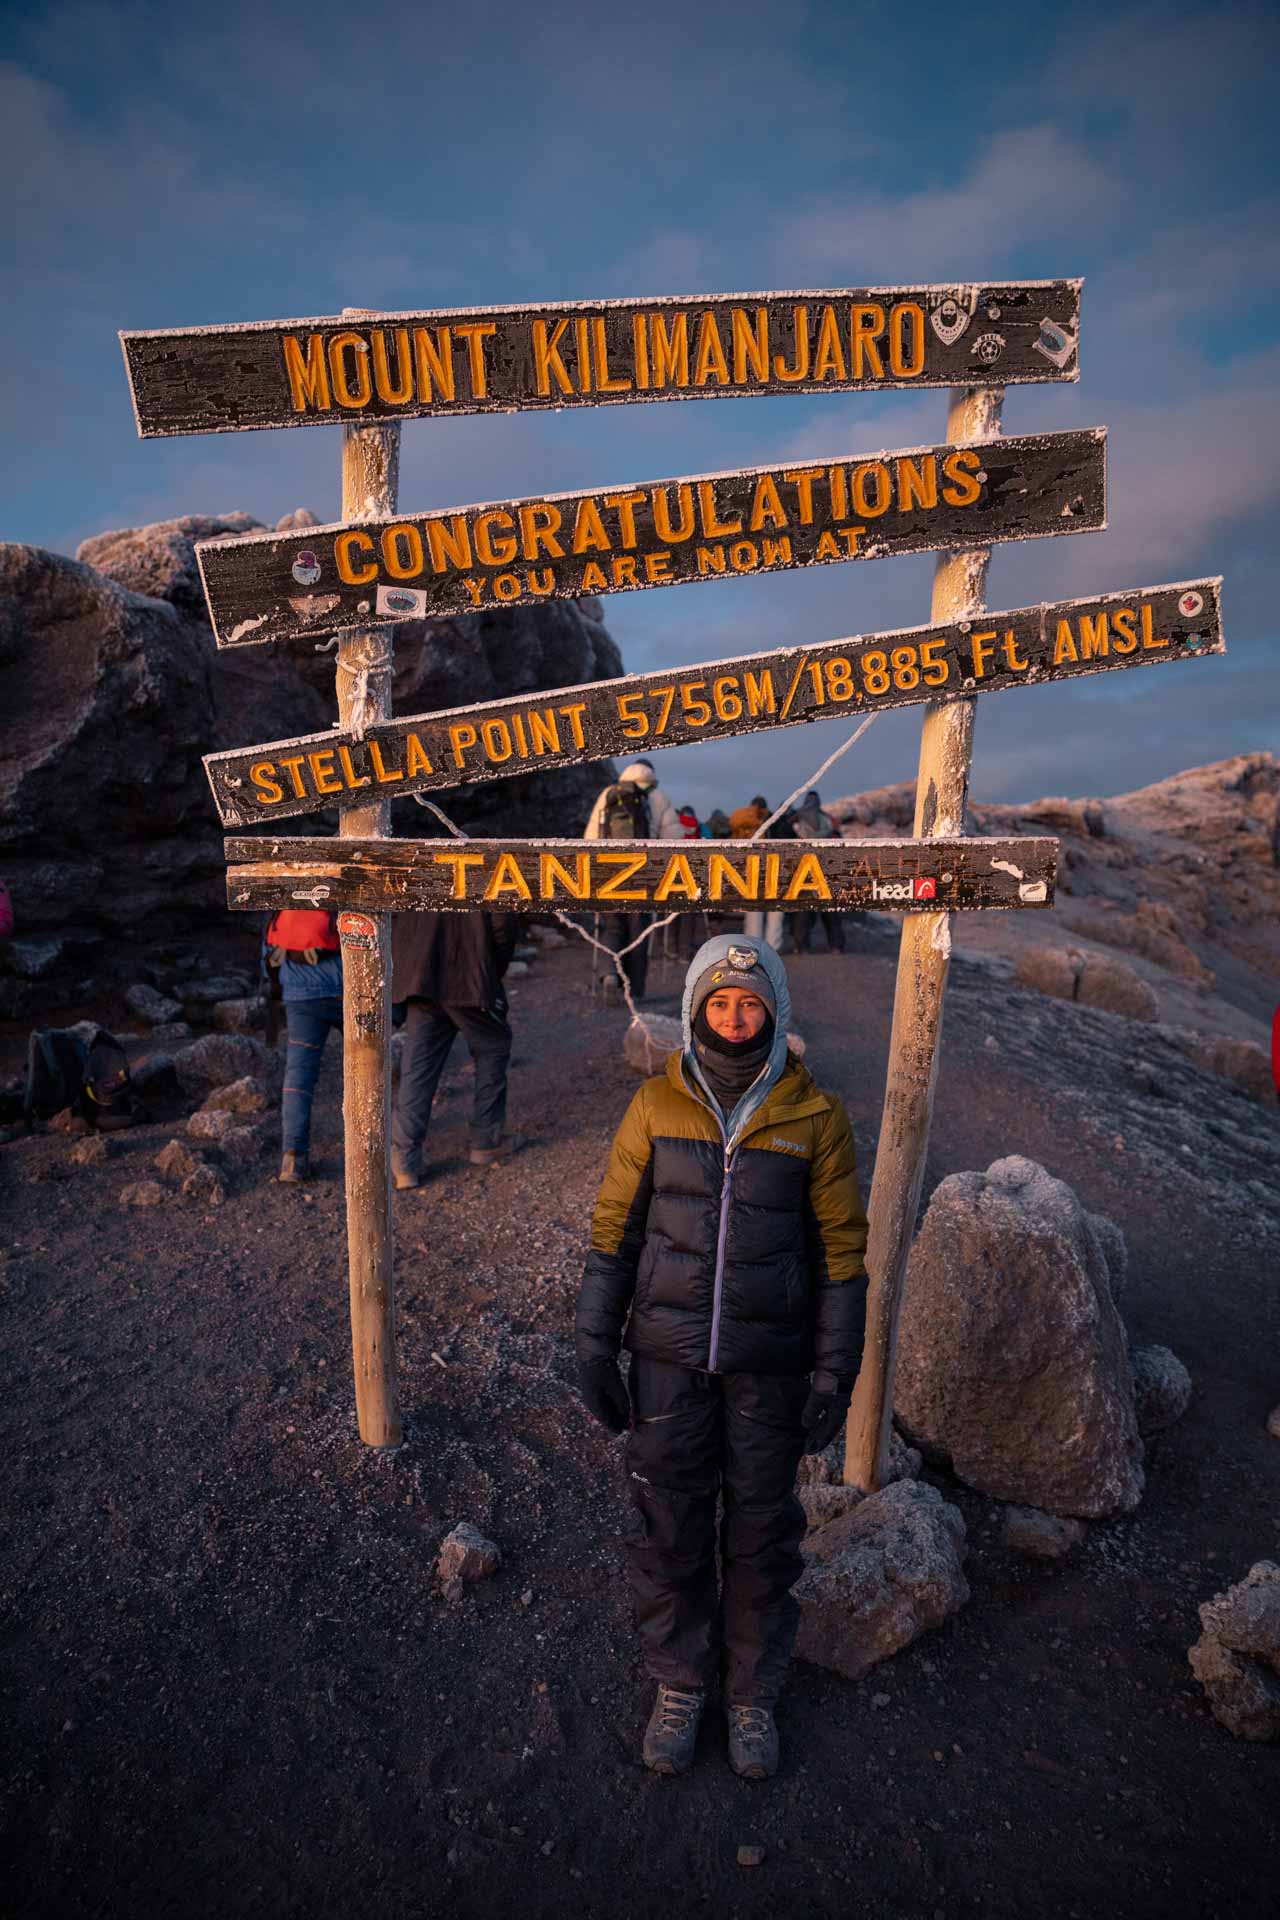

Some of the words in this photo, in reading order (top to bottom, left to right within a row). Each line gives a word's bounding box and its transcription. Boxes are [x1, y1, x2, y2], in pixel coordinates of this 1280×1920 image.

[283, 322, 497, 411] MOUNT
[532, 302, 925, 395] KILIMANJARO
[334, 450, 982, 585] CONGRATULATIONS
[463, 568, 556, 605] YOU
[581, 552, 673, 590] ARE
[696, 535, 792, 574] NOW
[815, 525, 867, 560] AT
[250, 733, 434, 803] STELLA
[448, 703, 587, 768] POINT
[971, 629, 1029, 677] Ft
[1053, 604, 1169, 664] AMSL
[434, 852, 832, 901] TANZANIA
[872, 878, 914, 900] head
